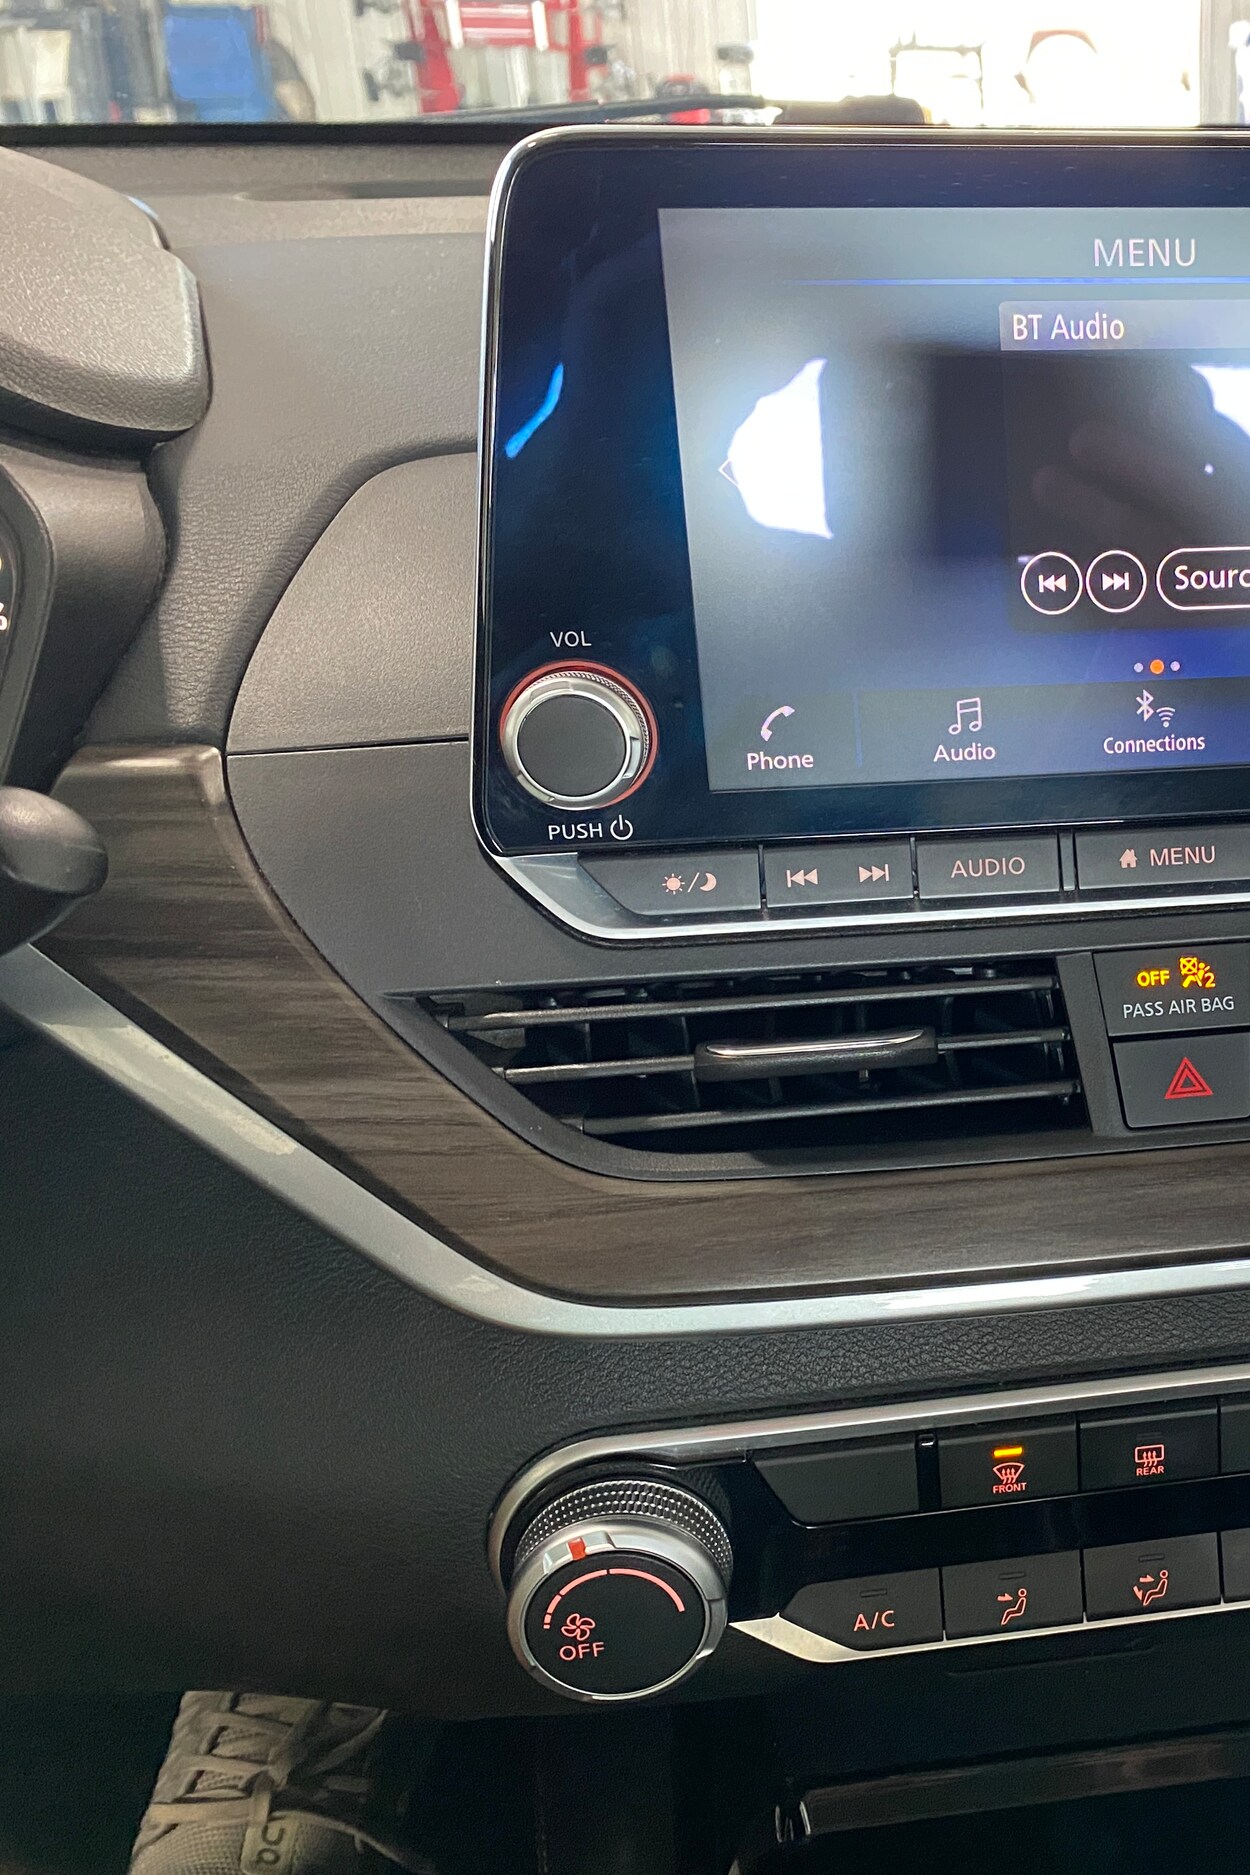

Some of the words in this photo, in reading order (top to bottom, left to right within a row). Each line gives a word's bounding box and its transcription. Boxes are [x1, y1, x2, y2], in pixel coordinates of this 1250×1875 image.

[1093, 238, 1197, 268] MENU
[1012, 314, 1042, 341] BT
[1051, 312, 1125, 341] Audio
[550, 630, 592, 648] VOL
[933, 743, 996, 763] Audio
[1103, 734, 1206, 755] Connections
[746, 751, 814, 771] Phone
[548, 823, 603, 841] PUSH
[1149, 846, 1216, 867] MENU
[951, 856, 1026, 879] AUDIO
[1136, 969, 1170, 987] OFF
[1122, 1002, 1164, 1019] PASS
[1168, 998, 1197, 1015] AIR
[1201, 996, 1235, 1012] BAG
[1136, 1465, 1165, 1476] REAR
[992, 1481, 1027, 1494] FRONT
[853, 1610, 896, 1631] A/C
[559, 1642, 605, 1661] OFF
